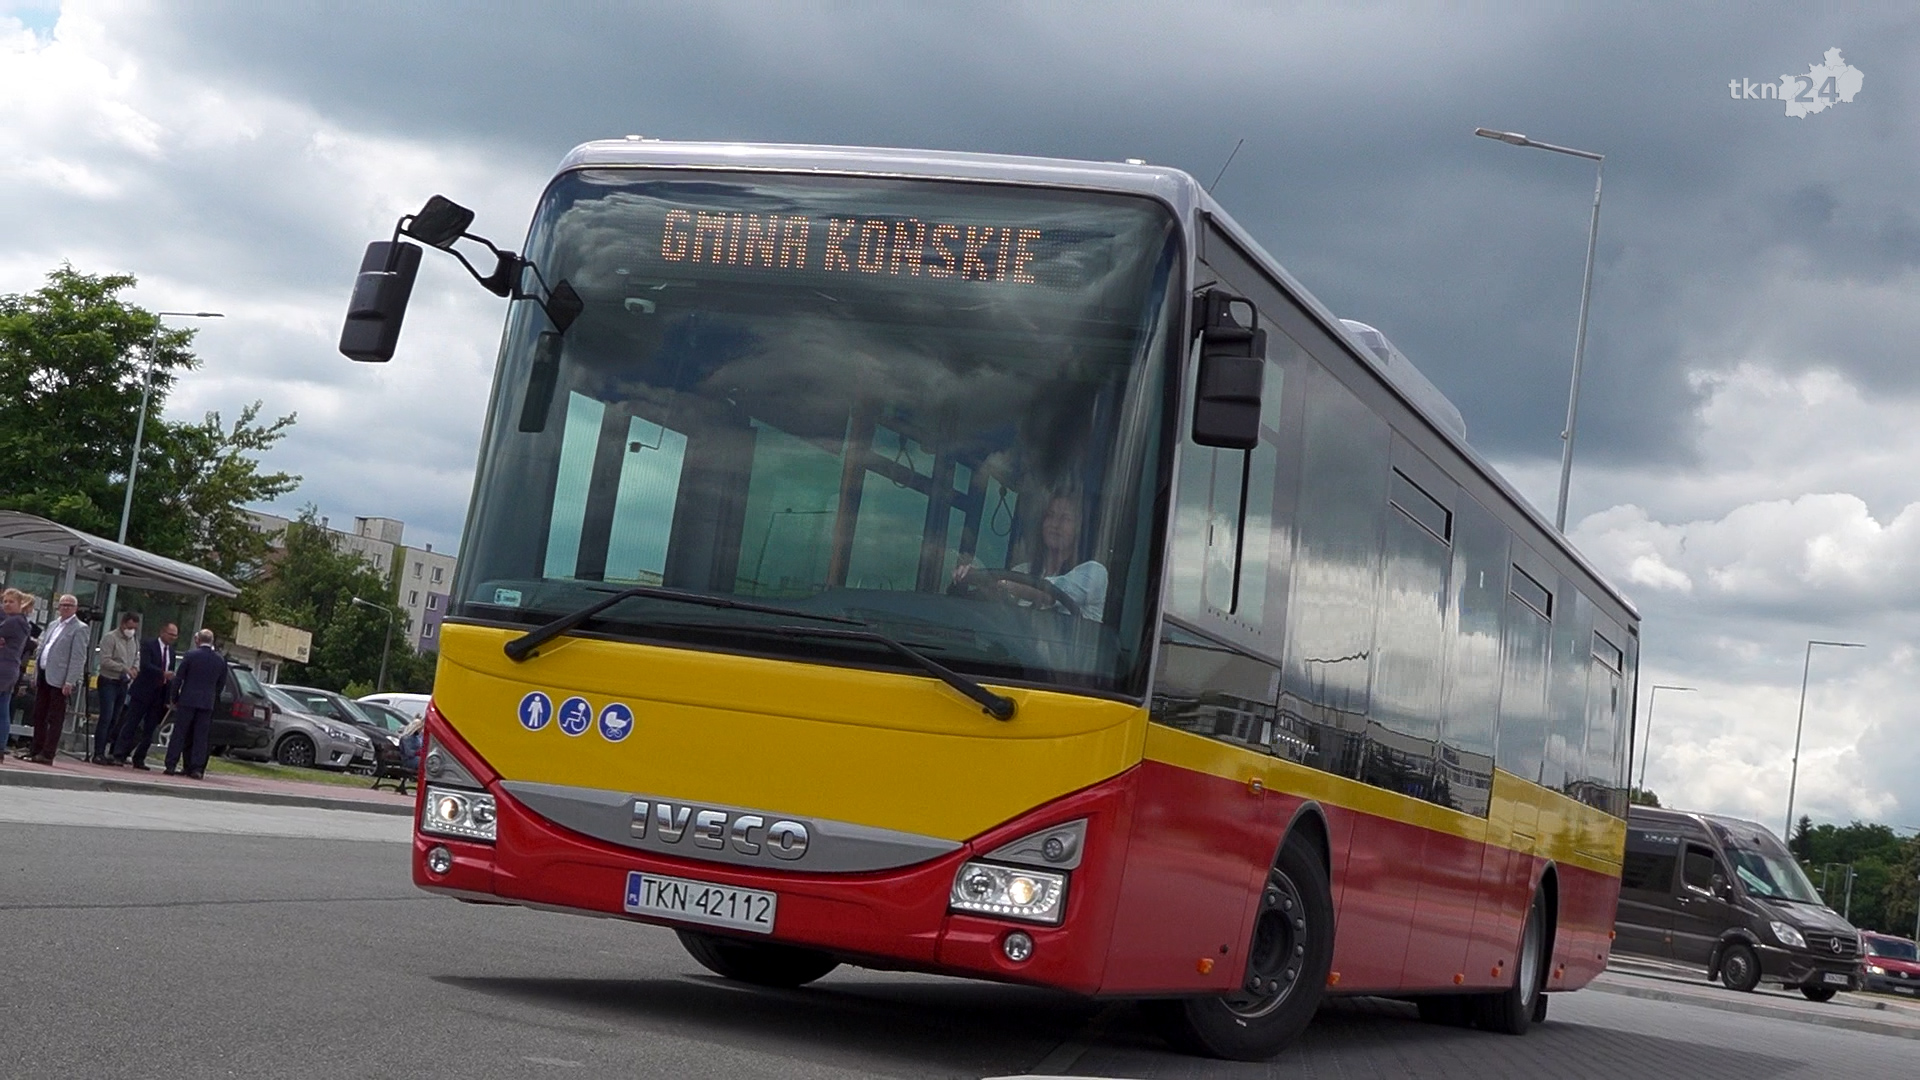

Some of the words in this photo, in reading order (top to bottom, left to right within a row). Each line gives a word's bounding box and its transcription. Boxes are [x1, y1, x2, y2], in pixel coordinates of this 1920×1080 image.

[661, 209, 811, 269] GMINA
[630, 801, 809, 861] IVECO
[643, 878, 689, 911] TKN
[695, 888, 771, 923] 42112
